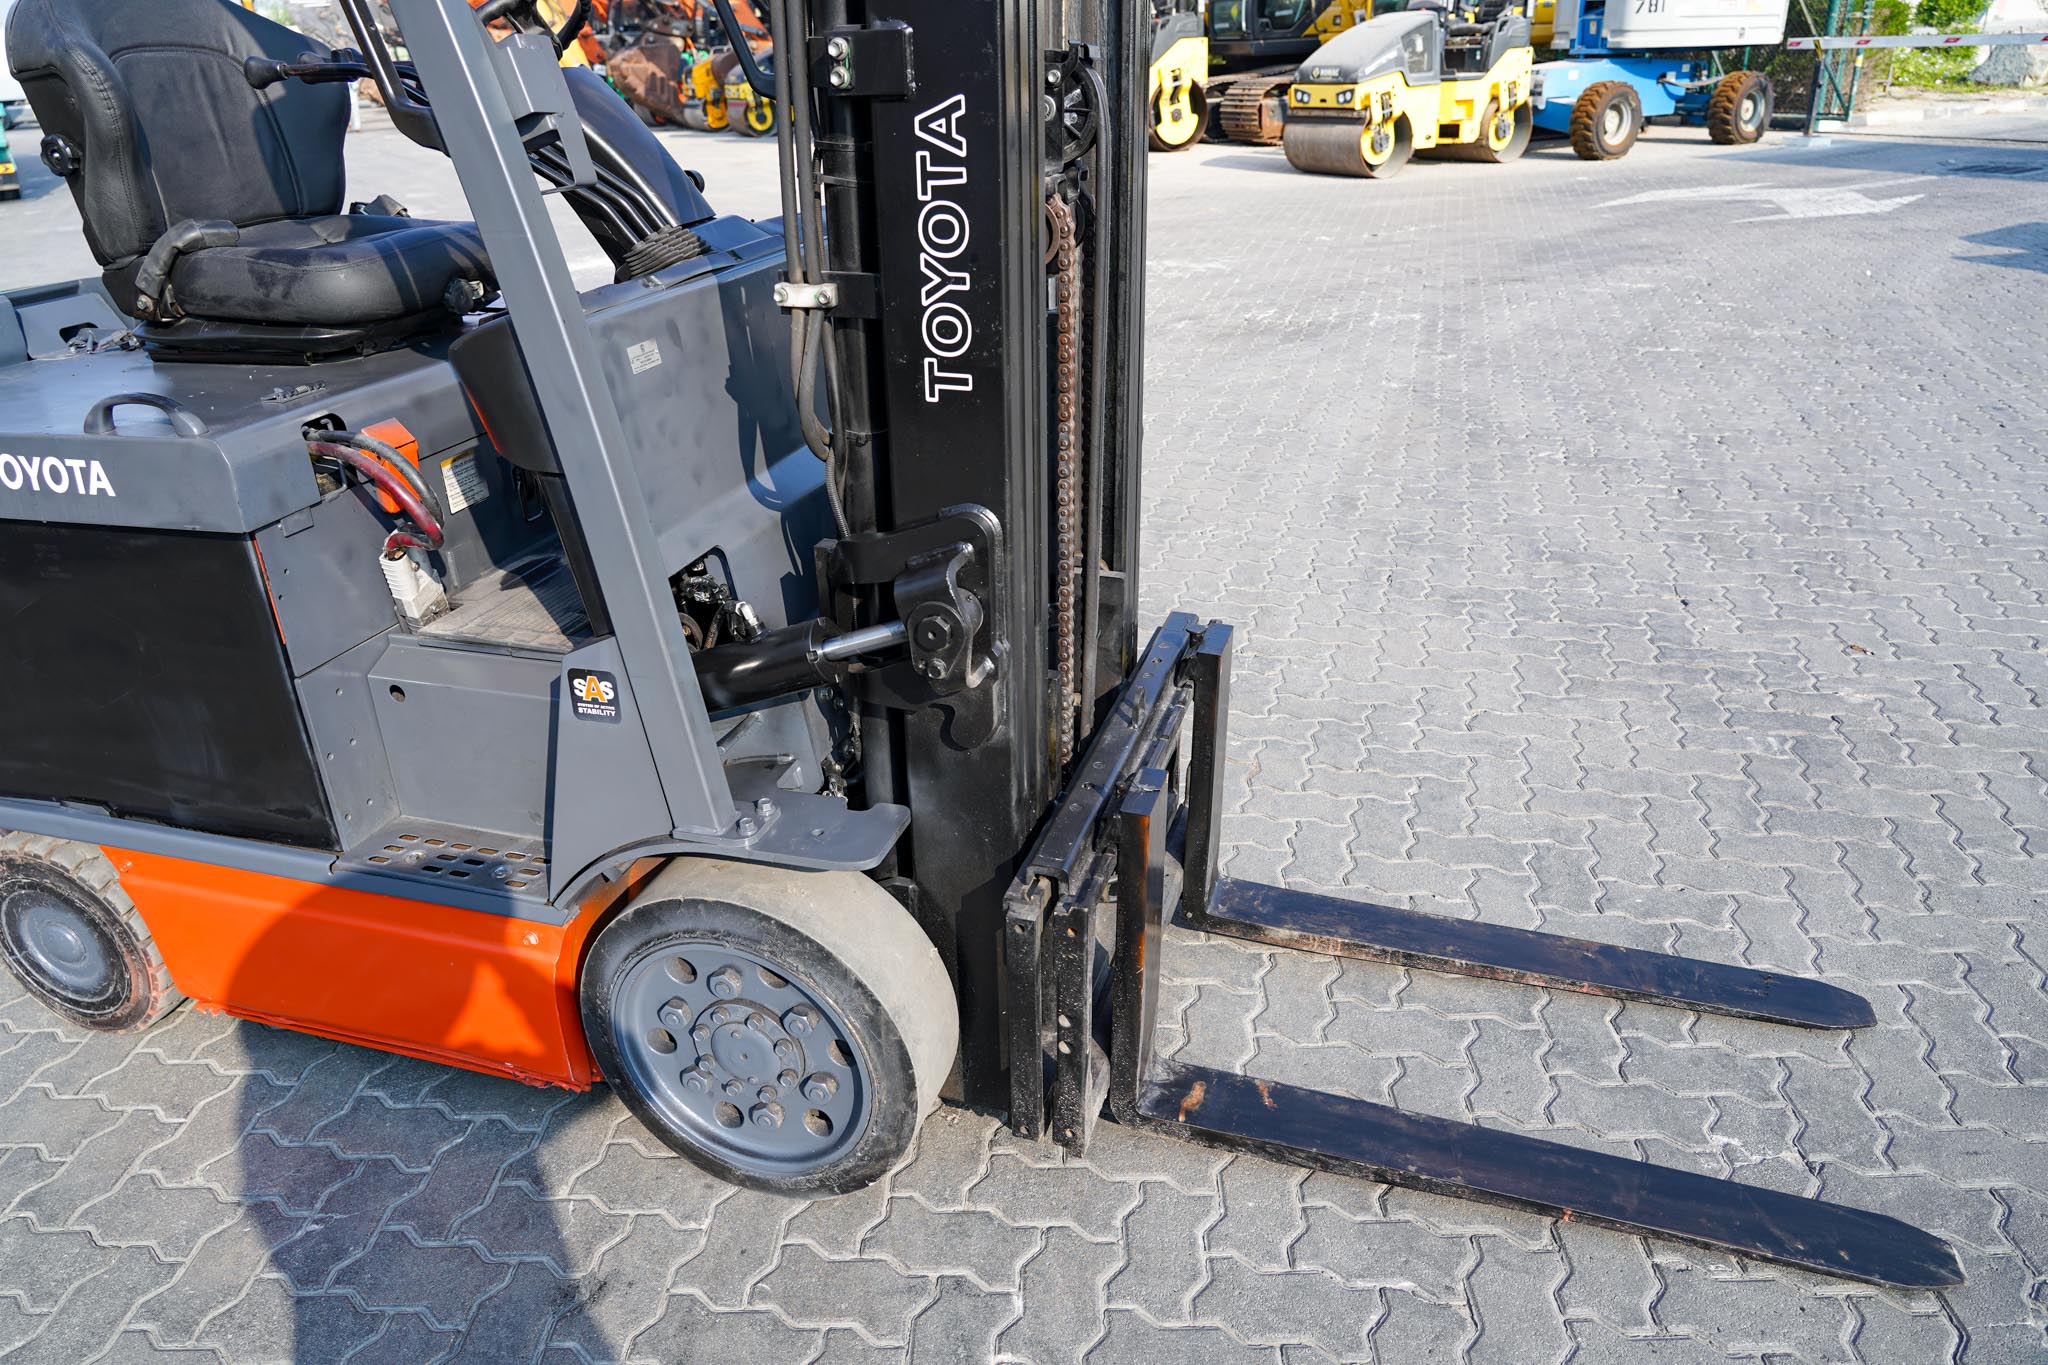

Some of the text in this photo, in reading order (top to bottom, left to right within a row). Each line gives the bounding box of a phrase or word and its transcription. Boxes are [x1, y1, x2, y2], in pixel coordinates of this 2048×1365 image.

[914, 94, 973, 402] TOYOTA
[573, 675, 615, 703] SAS
[578, 706, 616, 717] STABILITY
